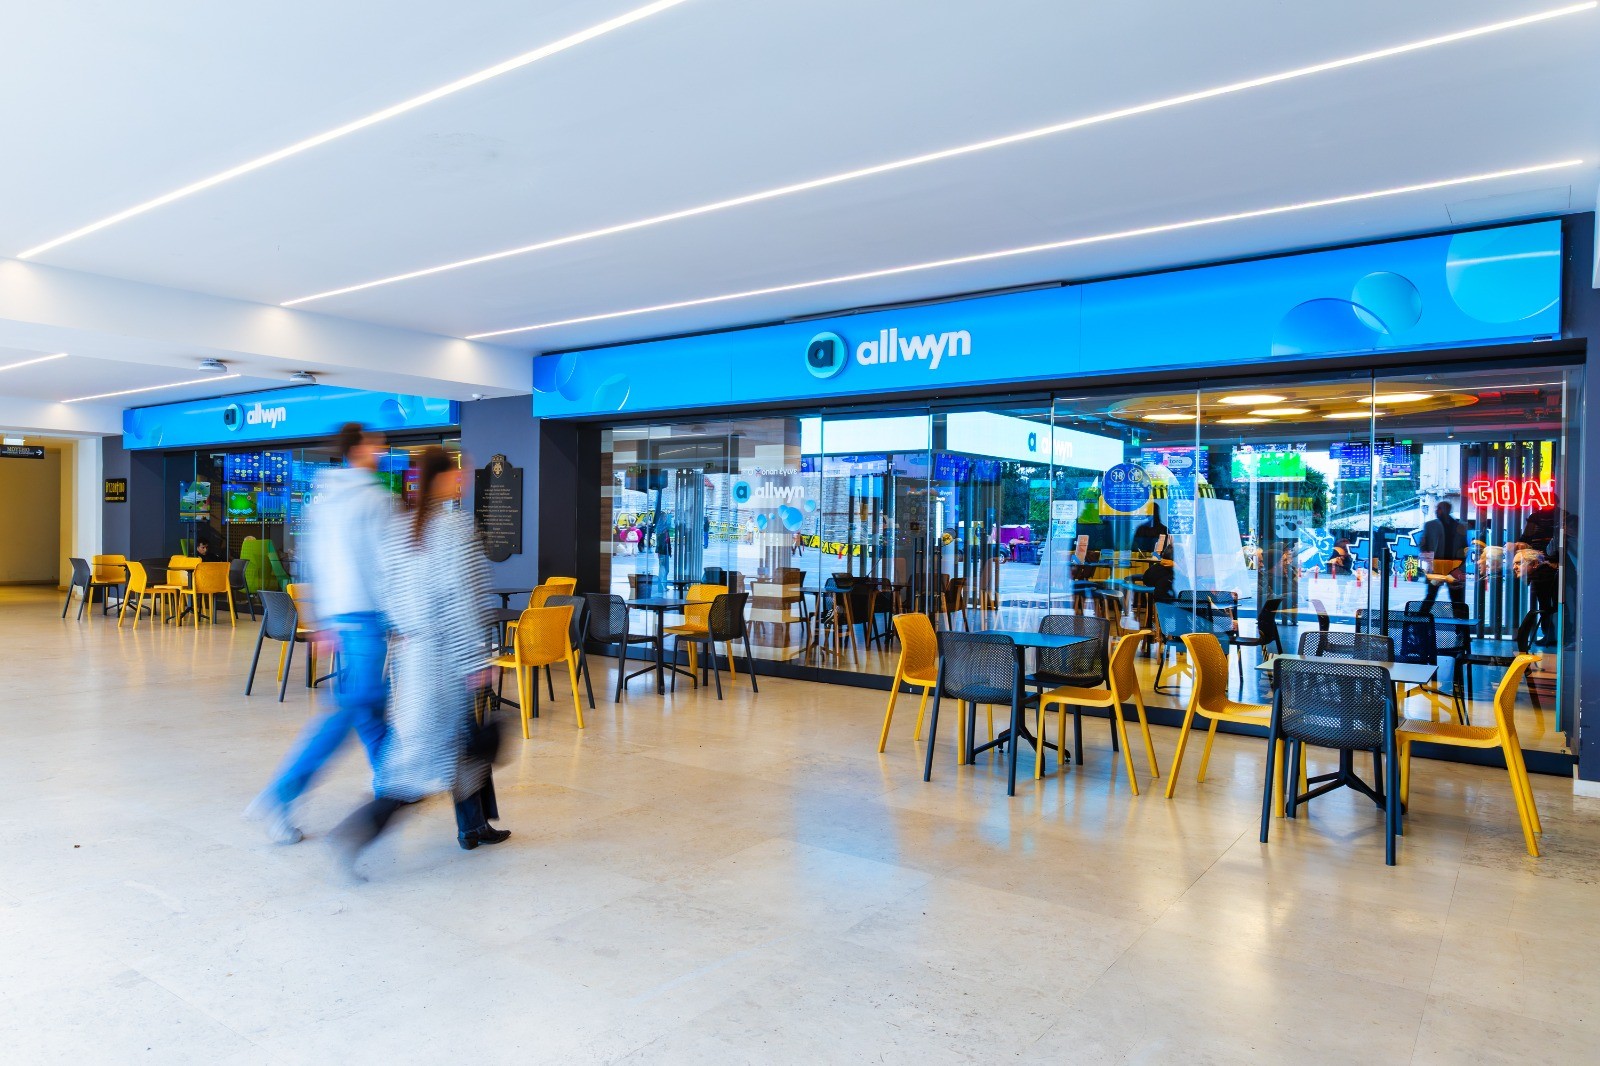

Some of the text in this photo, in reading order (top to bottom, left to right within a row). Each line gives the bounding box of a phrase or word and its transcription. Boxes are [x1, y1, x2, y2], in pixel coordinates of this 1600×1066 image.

[856, 327, 971, 370] allwyn
[246, 402, 286, 429] allwyn
[754, 481, 805, 503] allwyn
